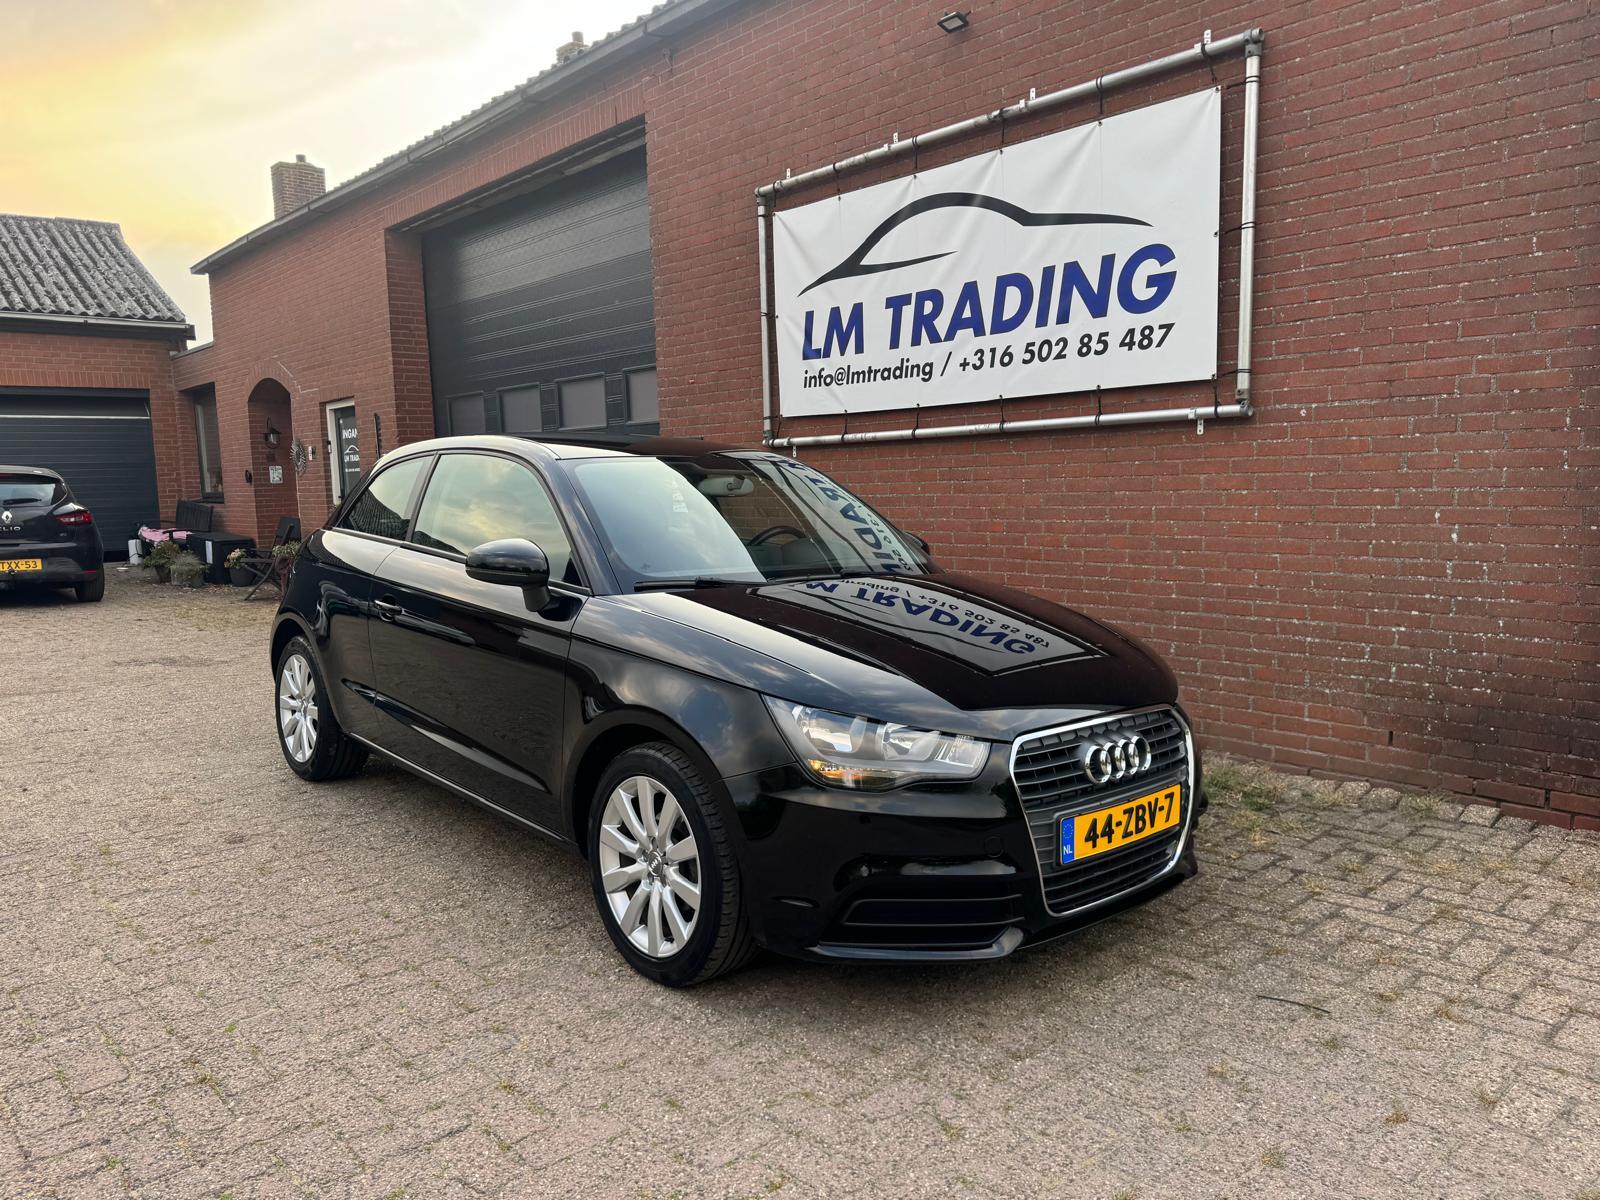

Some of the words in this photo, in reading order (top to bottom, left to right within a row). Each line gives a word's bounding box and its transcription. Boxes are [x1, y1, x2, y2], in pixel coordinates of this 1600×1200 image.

[802, 302, 865, 361] LM
[885, 243, 1177, 350] TRADING
[803, 358, 934, 389] info@lmtrading
[940, 352, 952, 376] /
[959, 347, 1013, 372] +316
[1022, 338, 1067, 365] 502
[1077, 331, 1109, 358] 85
[1119, 322, 1175, 352] 487
[1063, 845, 1073, 855] NL
[1084, 791, 1175, 849] 44-ZBV-7
